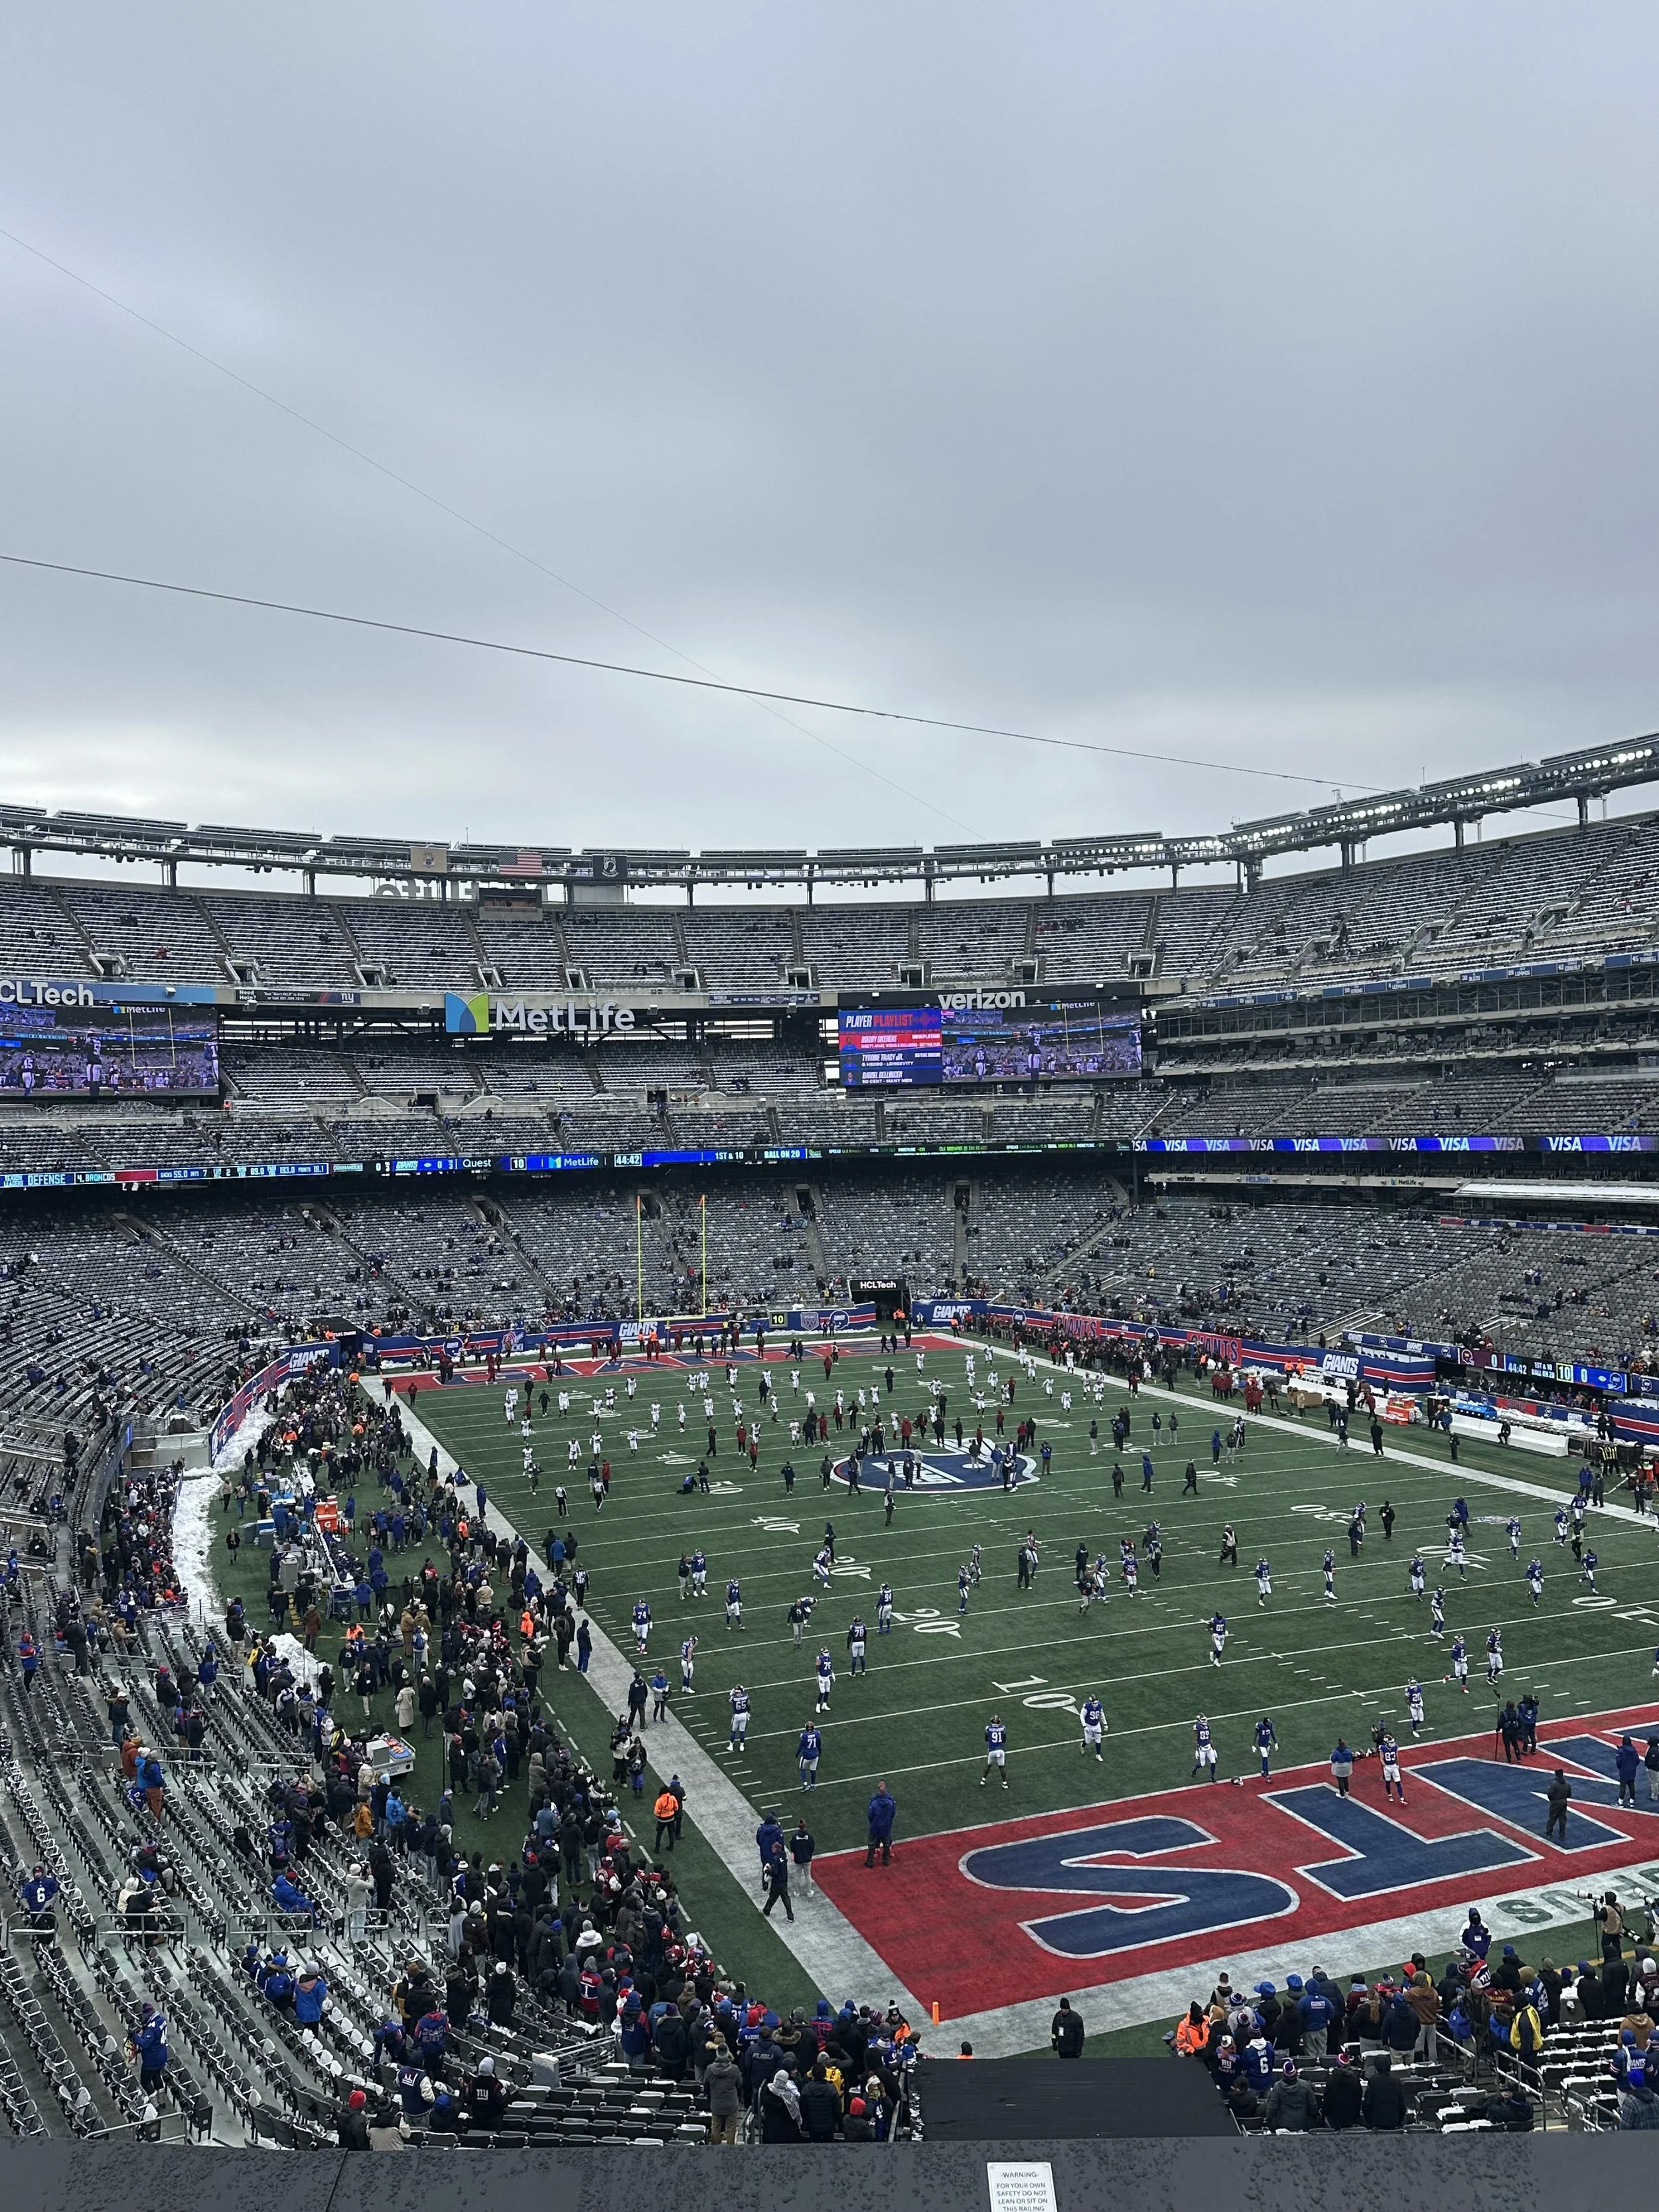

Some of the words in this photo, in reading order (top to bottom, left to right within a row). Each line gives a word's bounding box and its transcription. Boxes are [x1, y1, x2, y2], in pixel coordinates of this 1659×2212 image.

[938, 988, 1026, 1010] verizon
[496, 1000, 636, 1031] MetLife
[846, 1015, 873, 1028] PLAYER
[873, 1014, 913, 1027] PLAYLIST
[1163, 1140, 1188, 1151] VISA
[1204, 1139, 1230, 1151] VISA
[1248, 1139, 1274, 1151] VISA
[1291, 1138, 1320, 1151] VISA
[1338, 1138, 1368, 1151] VISA
[1388, 1138, 1417, 1151] VISA
[1437, 1137, 1470, 1151] VISA
[1491, 1137, 1524, 1151] VISA
[1546, 1137, 1582, 1151] VISA
[1605, 1136, 1642, 1151] VISA
[563, 1157, 599, 1166] MetLife
[616, 1155, 640, 1165] 44:42
[715, 1151, 727, 1160] 1ST
[376, 1163, 382, 1171] 0
[396, 1160, 418, 1169] GIANTS
[463, 1159, 492, 1168] Quest
[513, 1159, 524, 1168] 10
[77, 1174, 85, 1183] 4.
[85, 1173, 116, 1182] BRONCOS
[173, 1170, 188, 1179] 55.0
[279, 1165, 295, 1174] 193.0
[28, 1173, 66, 1185] DEFENSE
[860, 1281, 897, 1290] HCLTech
[932, 1305, 972, 1319] GIANTS
[772, 1315, 784, 1324] 10
[619, 1322, 658, 1337] GIANTS
[1406, 1341, 1423, 1351] GIANTS
[1322, 1353, 1359, 1375] GIANTS
[1490, 1354, 1498, 1367] 0
[1508, 1362, 1527, 1375] 44:42
[1532, 1368, 1542, 1376] BALL
[1559, 1366, 1571, 1380] 10
[1581, 1368, 1588, 1382] 0
[656, 1453, 697, 1465] 40
[1194, 1470, 1242, 1484] 40
[1290, 1504, 1354, 1521] 30
[751, 1516, 801, 1531] 40
[884, 1593, 893, 1603] 94
[890, 1608, 961, 1633] 20
[854, 1629, 865, 1638] 78
[991, 1675, 1076, 1708] 10
[1412, 1693, 1421, 1702] 20
[735, 1701, 747, 1710] 65
[991, 1732, 1002, 1743] 91
[1199, 1732, 1210, 1740] 89
[807, 1739, 816, 1749] 71
[36, 1887, 45, 1903] 6
[584, 1985, 589, 1997] 1
[1524, 1987, 1534, 1996] 92
[731, 2010, 740, 2022] 31
[1260, 2057, 1268, 2073] 6
[476, 2089, 488, 2101] ny
